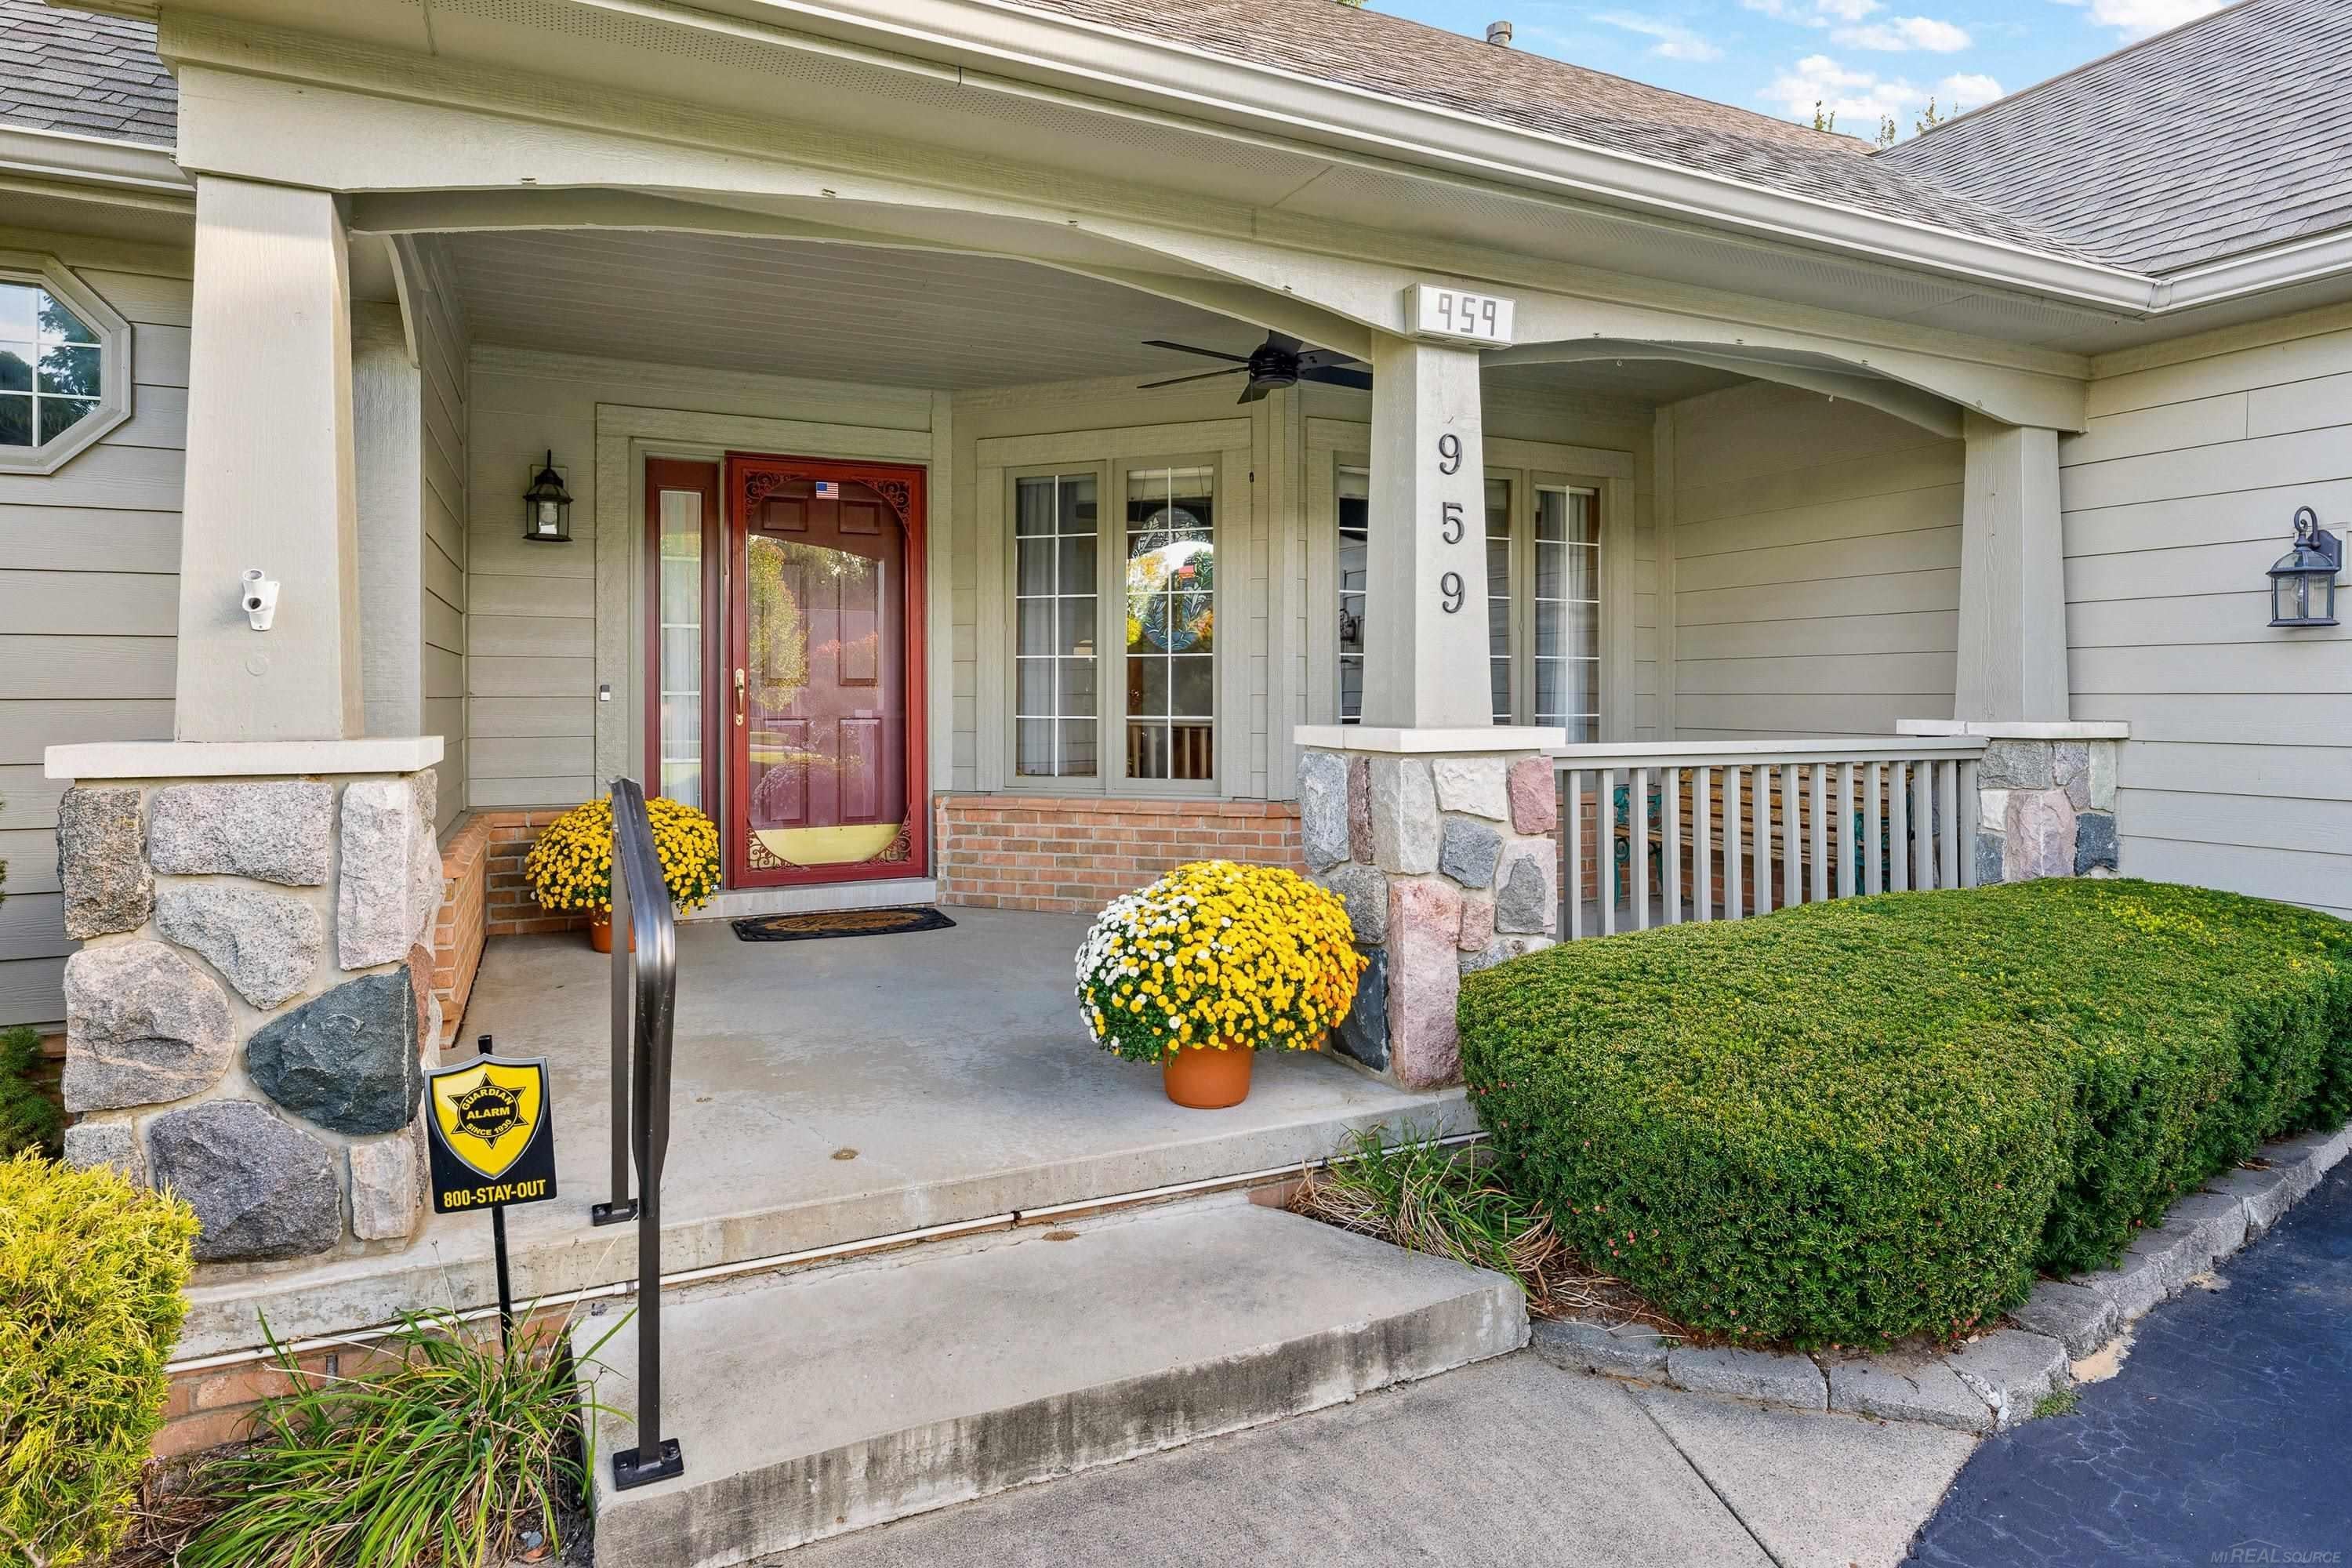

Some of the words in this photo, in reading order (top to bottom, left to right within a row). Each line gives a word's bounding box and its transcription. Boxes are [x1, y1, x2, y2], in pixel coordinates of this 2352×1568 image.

[1438, 292, 1497, 337] 959
[1438, 433, 1466, 614] 959
[462, 1088, 514, 1110] GUARDIAN
[466, 1106, 510, 1120] ALARM
[466, 1123, 492, 1135] SINCE
[494, 1119, 512, 1134] 1930
[444, 1179, 546, 1207] 800-STAY-OUT
